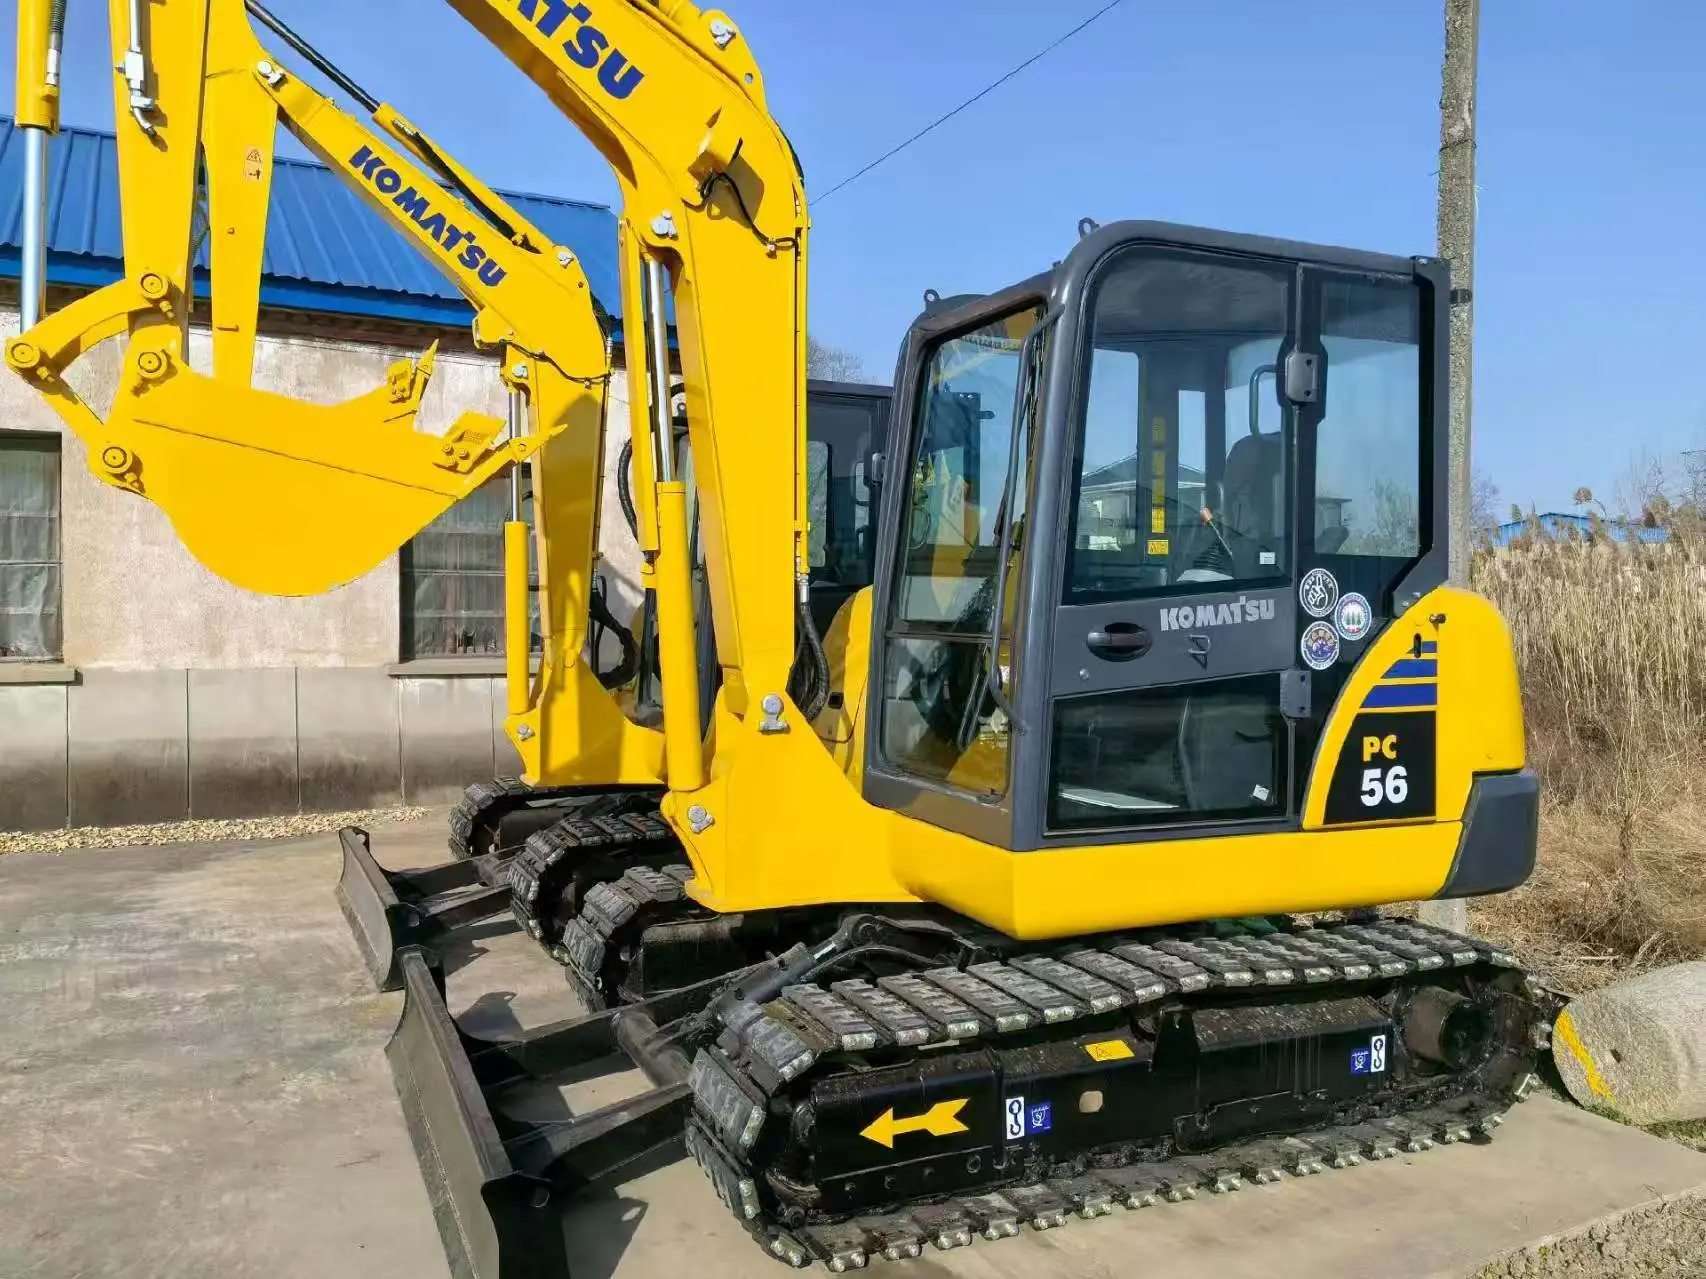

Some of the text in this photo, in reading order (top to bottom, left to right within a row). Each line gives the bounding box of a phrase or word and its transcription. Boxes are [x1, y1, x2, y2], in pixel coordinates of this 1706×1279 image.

[348, 144, 508, 287] KOMATSU
[1160, 595, 1275, 632] KOMATSU
[1363, 734, 1397, 762] PC
[1360, 765, 1408, 807] 56
